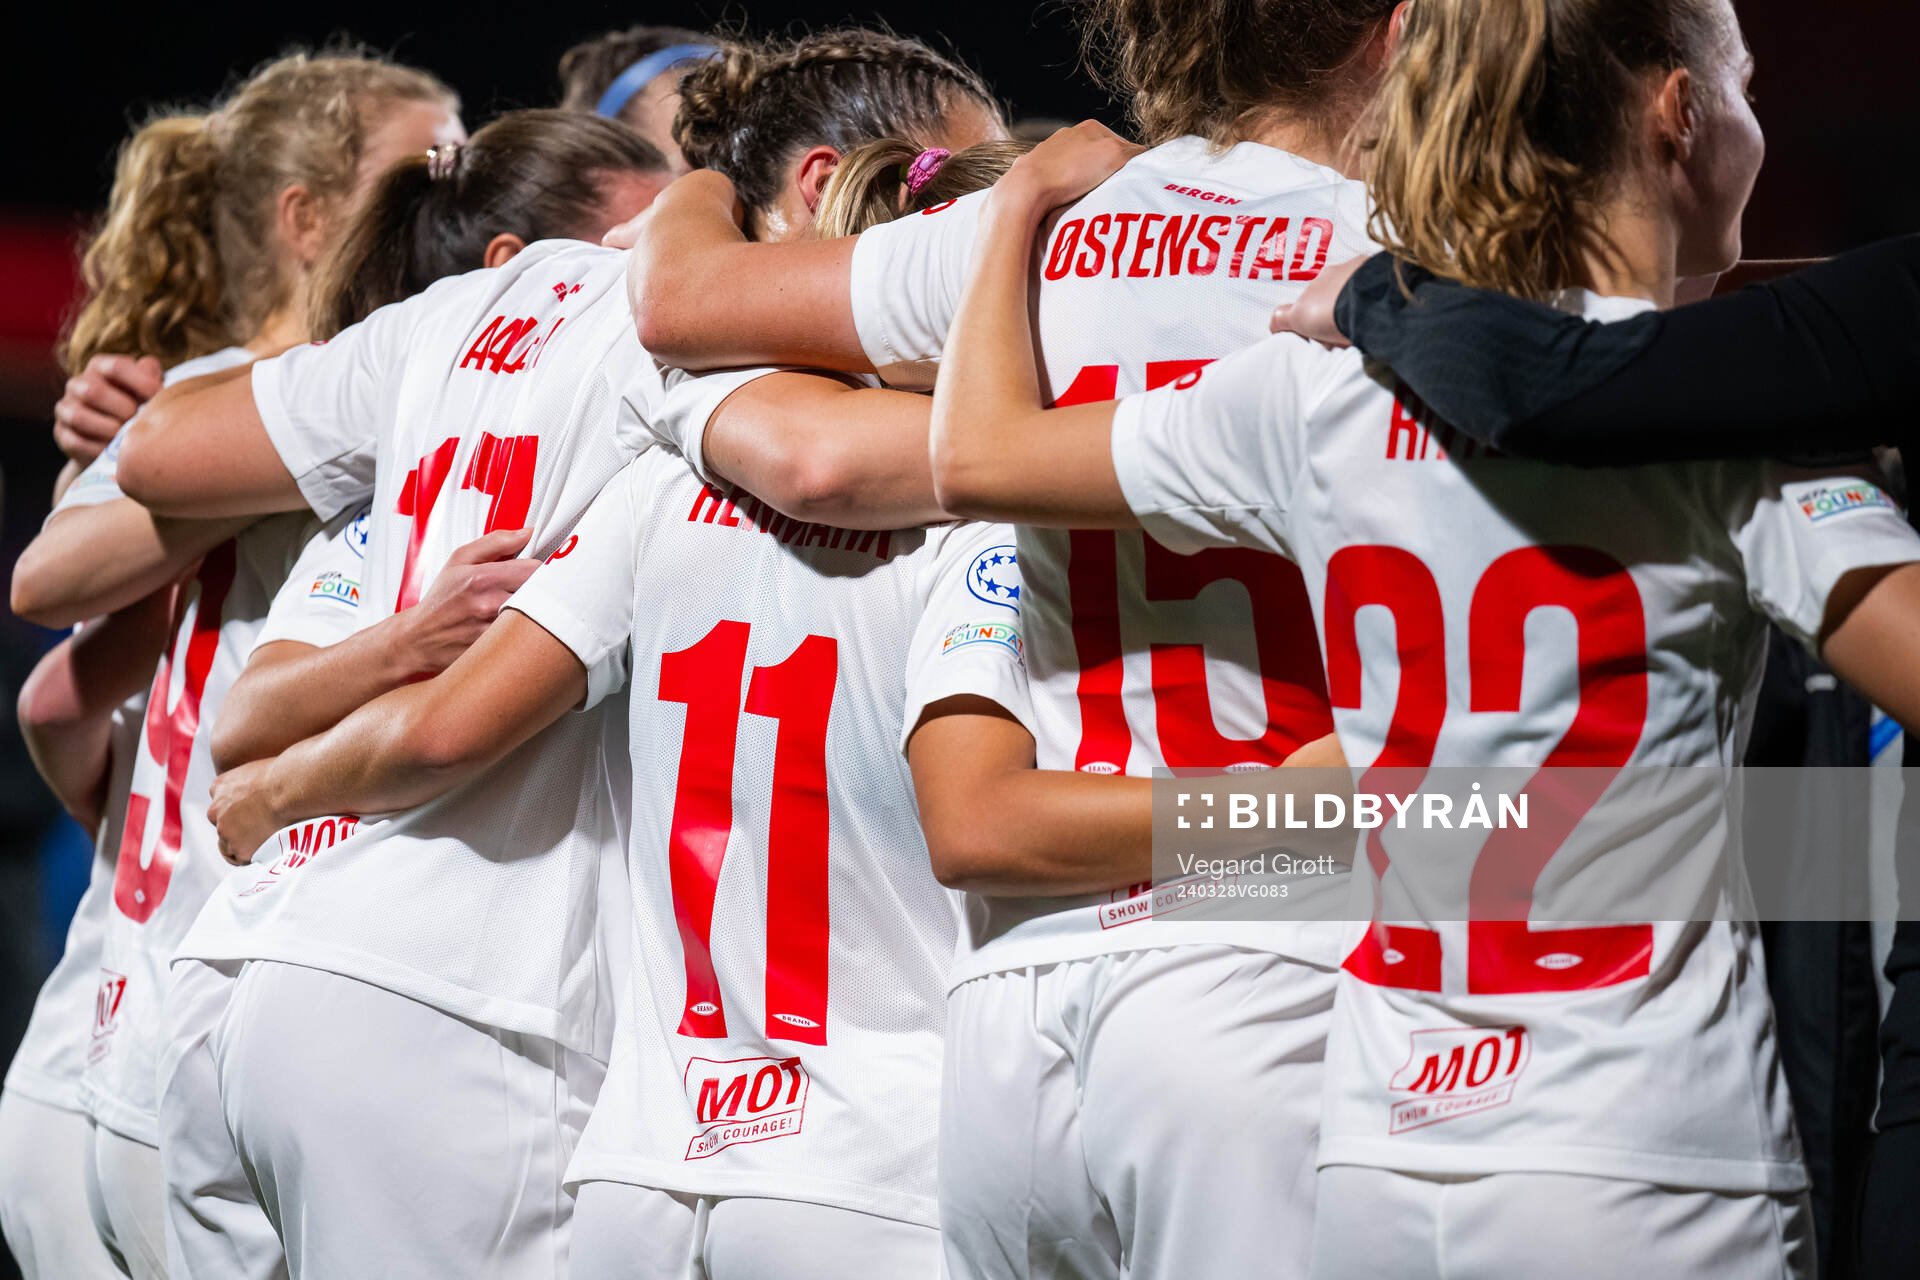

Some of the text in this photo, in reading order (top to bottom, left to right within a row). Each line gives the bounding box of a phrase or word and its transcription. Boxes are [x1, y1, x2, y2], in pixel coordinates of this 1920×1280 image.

[1163, 183, 1242, 206] BERGEN
[1044, 213, 1334, 281] ØSTENSTAD
[392, 431, 539, 614] 17
[1050, 359, 1334, 777] 15
[1323, 544, 1655, 994] 22
[657, 619, 838, 1045] 11
[1107, 901, 1149, 921] SHOW
[782, 1015, 811, 1026] BRANN
[697, 1057, 801, 1123] MOT
[1408, 1025, 1526, 1094] MOT
[723, 1117, 792, 1140] COURAGE!
